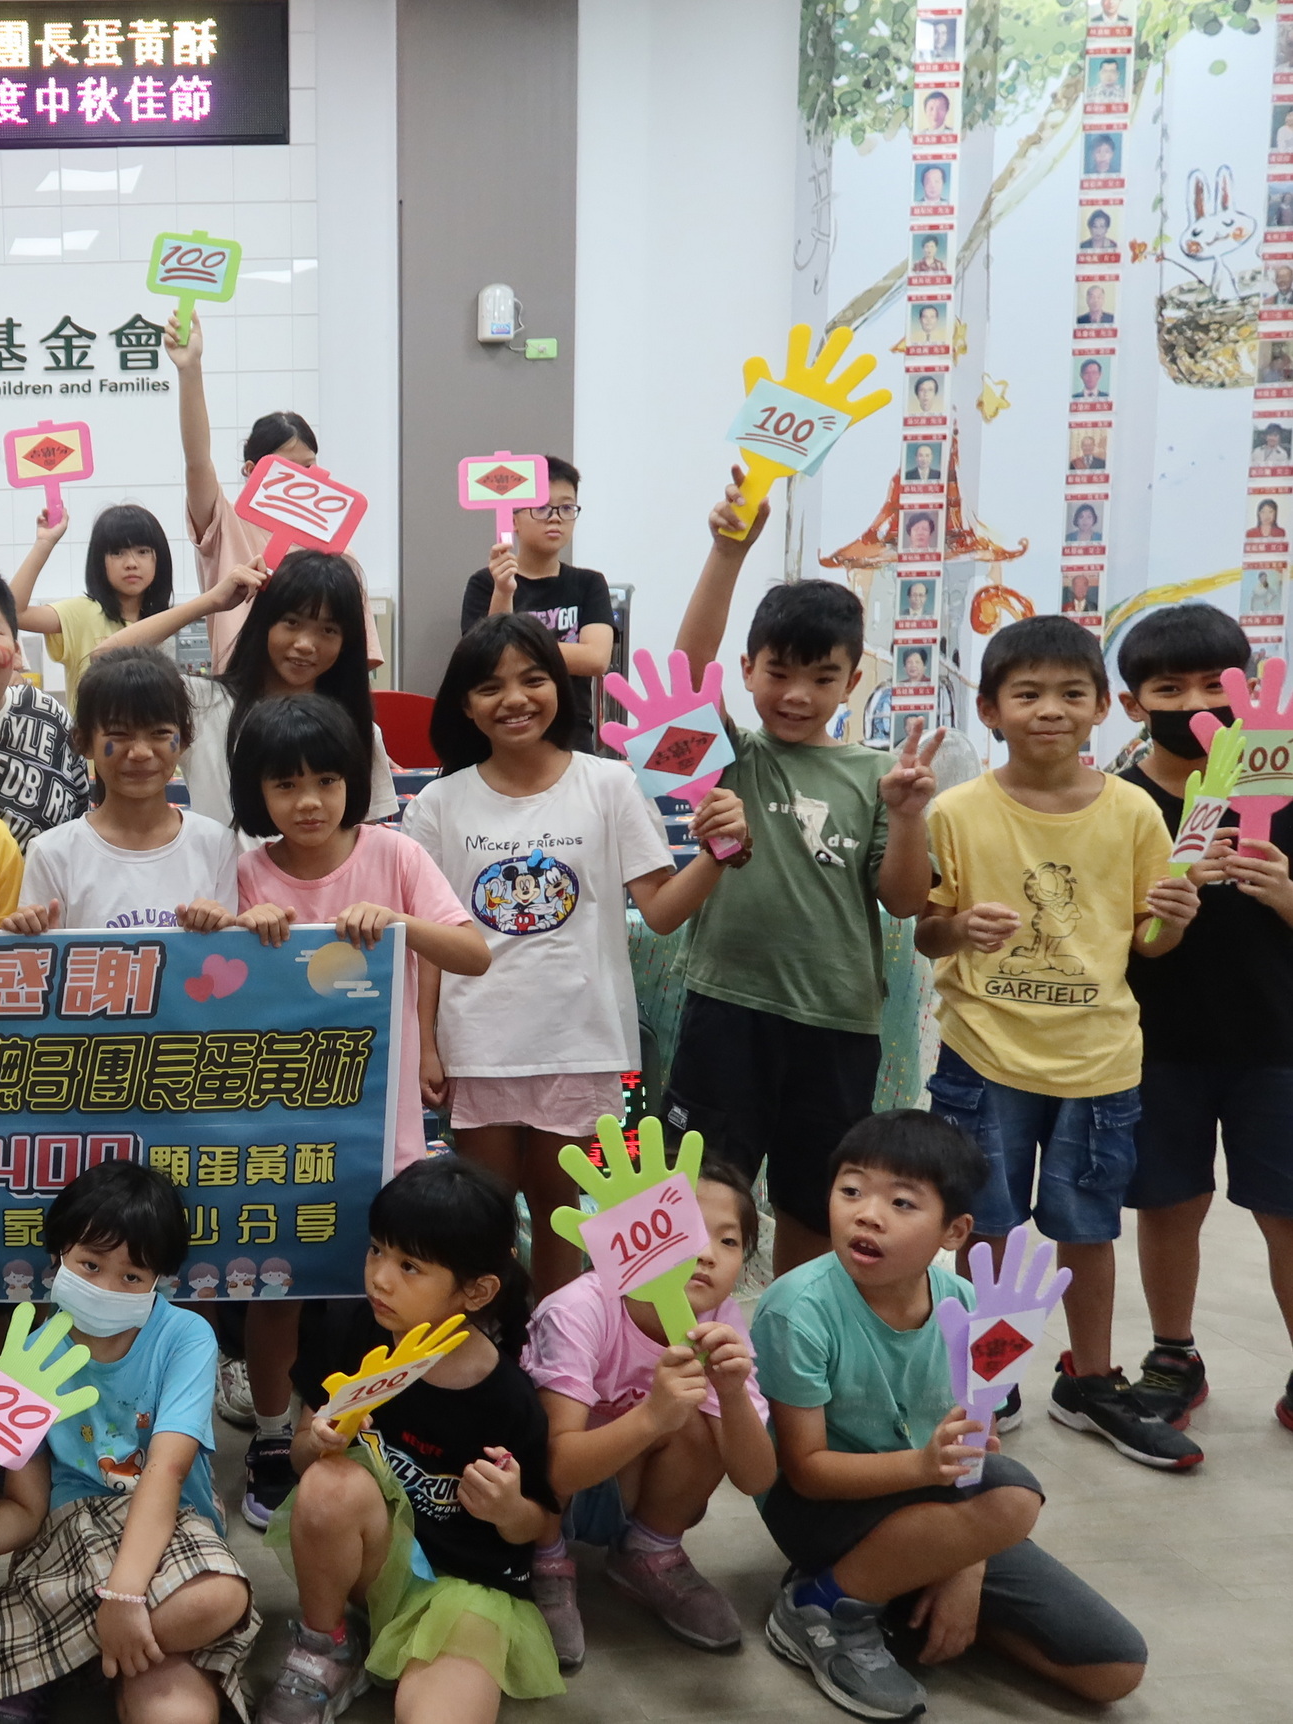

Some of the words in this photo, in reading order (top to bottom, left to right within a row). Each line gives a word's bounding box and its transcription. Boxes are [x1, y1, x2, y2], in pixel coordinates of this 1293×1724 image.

[160, 245, 226, 269] 100
[59, 379, 92, 395] and
[99, 378, 170, 393] Families
[753, 406, 815, 444] 100
[261, 471, 348, 512] 100
[1181, 803, 1223, 836] 100
[985, 979, 1099, 1004] GARFIELD
[610, 1208, 673, 1266] 100
[348, 1371, 410, 1403] 100
